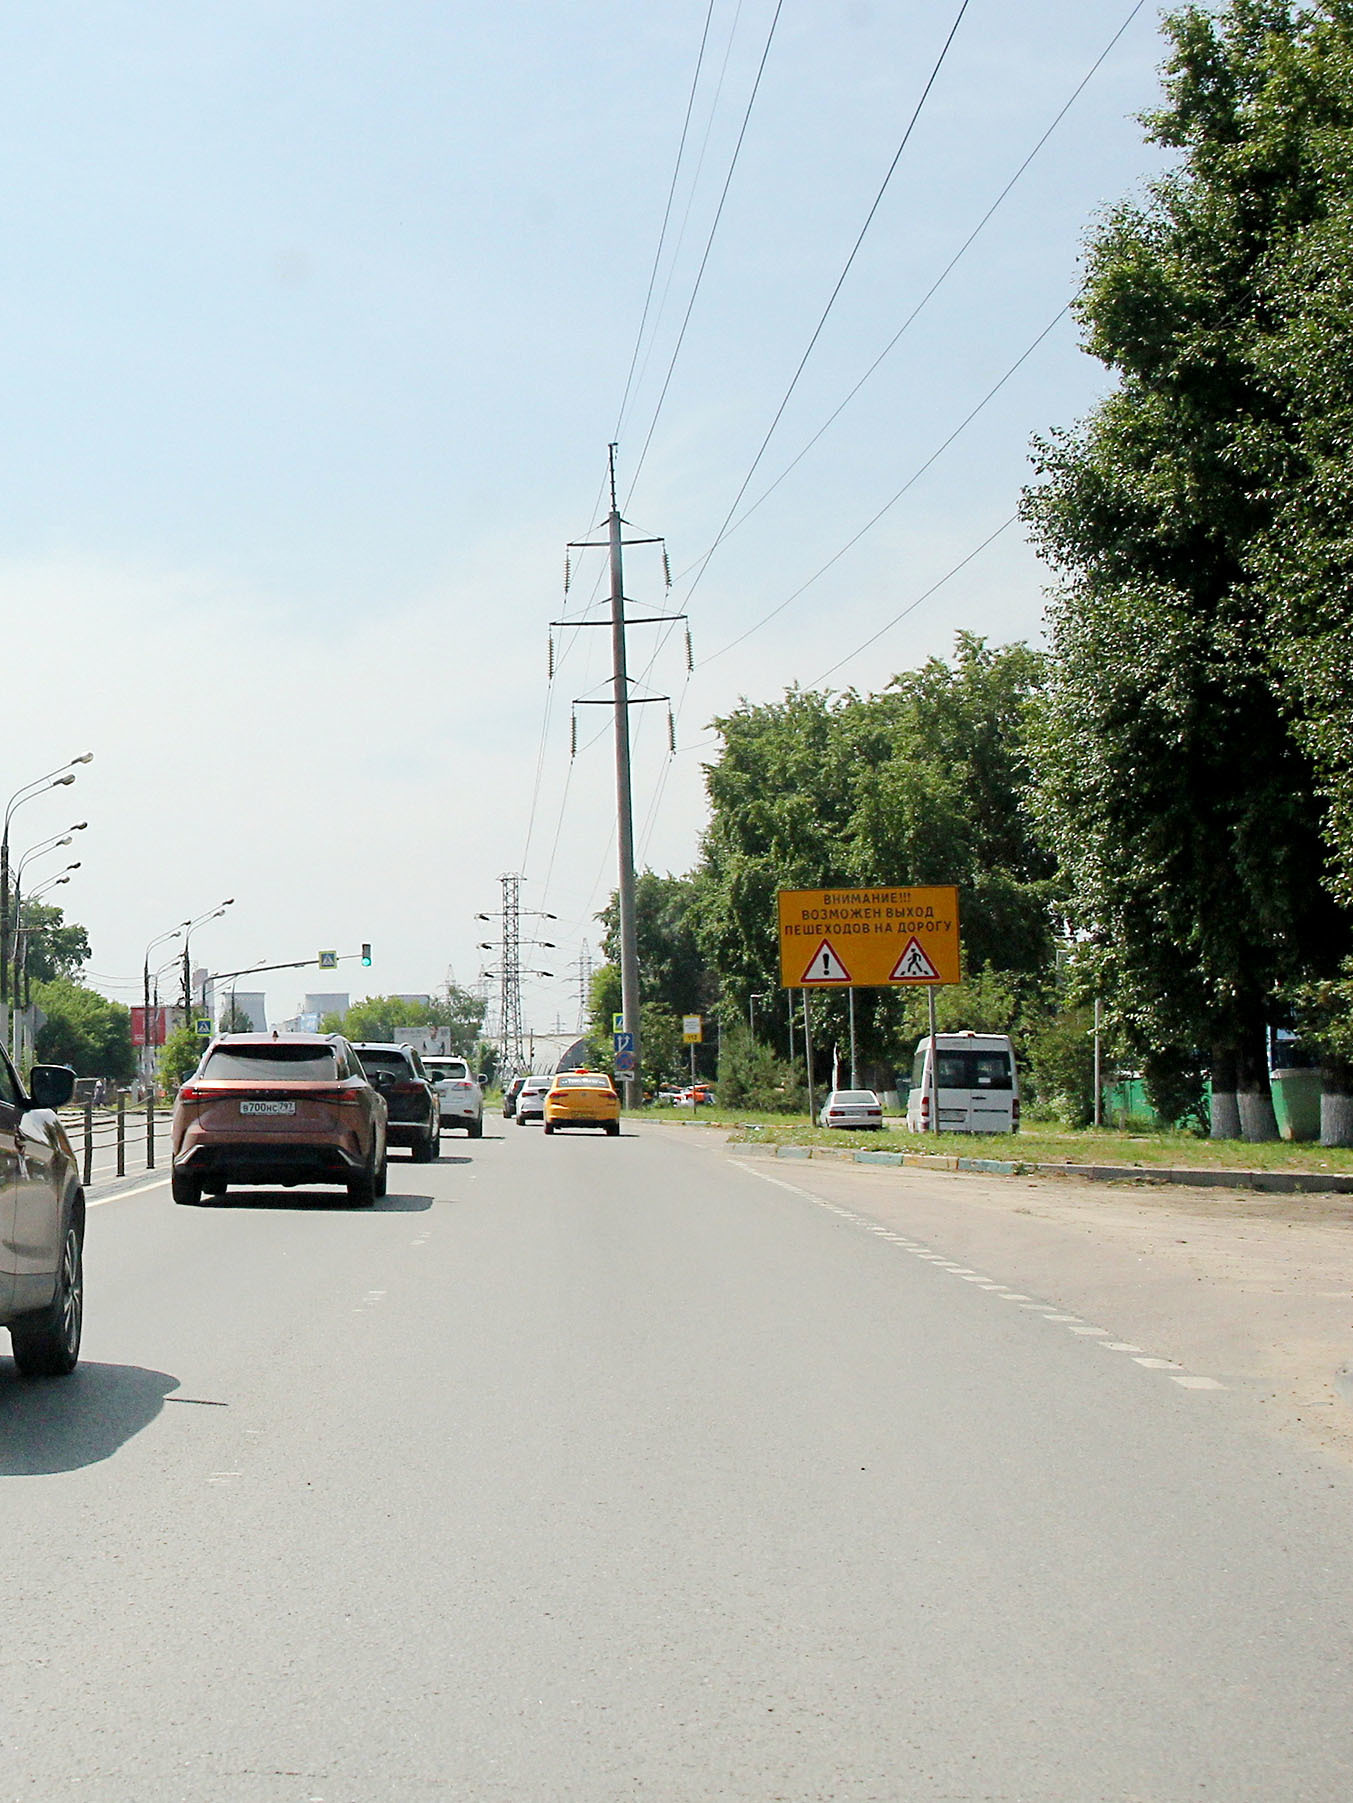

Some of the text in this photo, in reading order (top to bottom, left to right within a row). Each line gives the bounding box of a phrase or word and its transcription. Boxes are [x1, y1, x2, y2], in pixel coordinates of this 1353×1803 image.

[823, 892, 911, 905] ВНИМАНИЕ!!!
[802, 906, 934, 921] ВОЗМОЖЕН ВЫХОД
[785, 920, 952, 935] ПЕШЕХОДОВ НА ДОРОГУ
